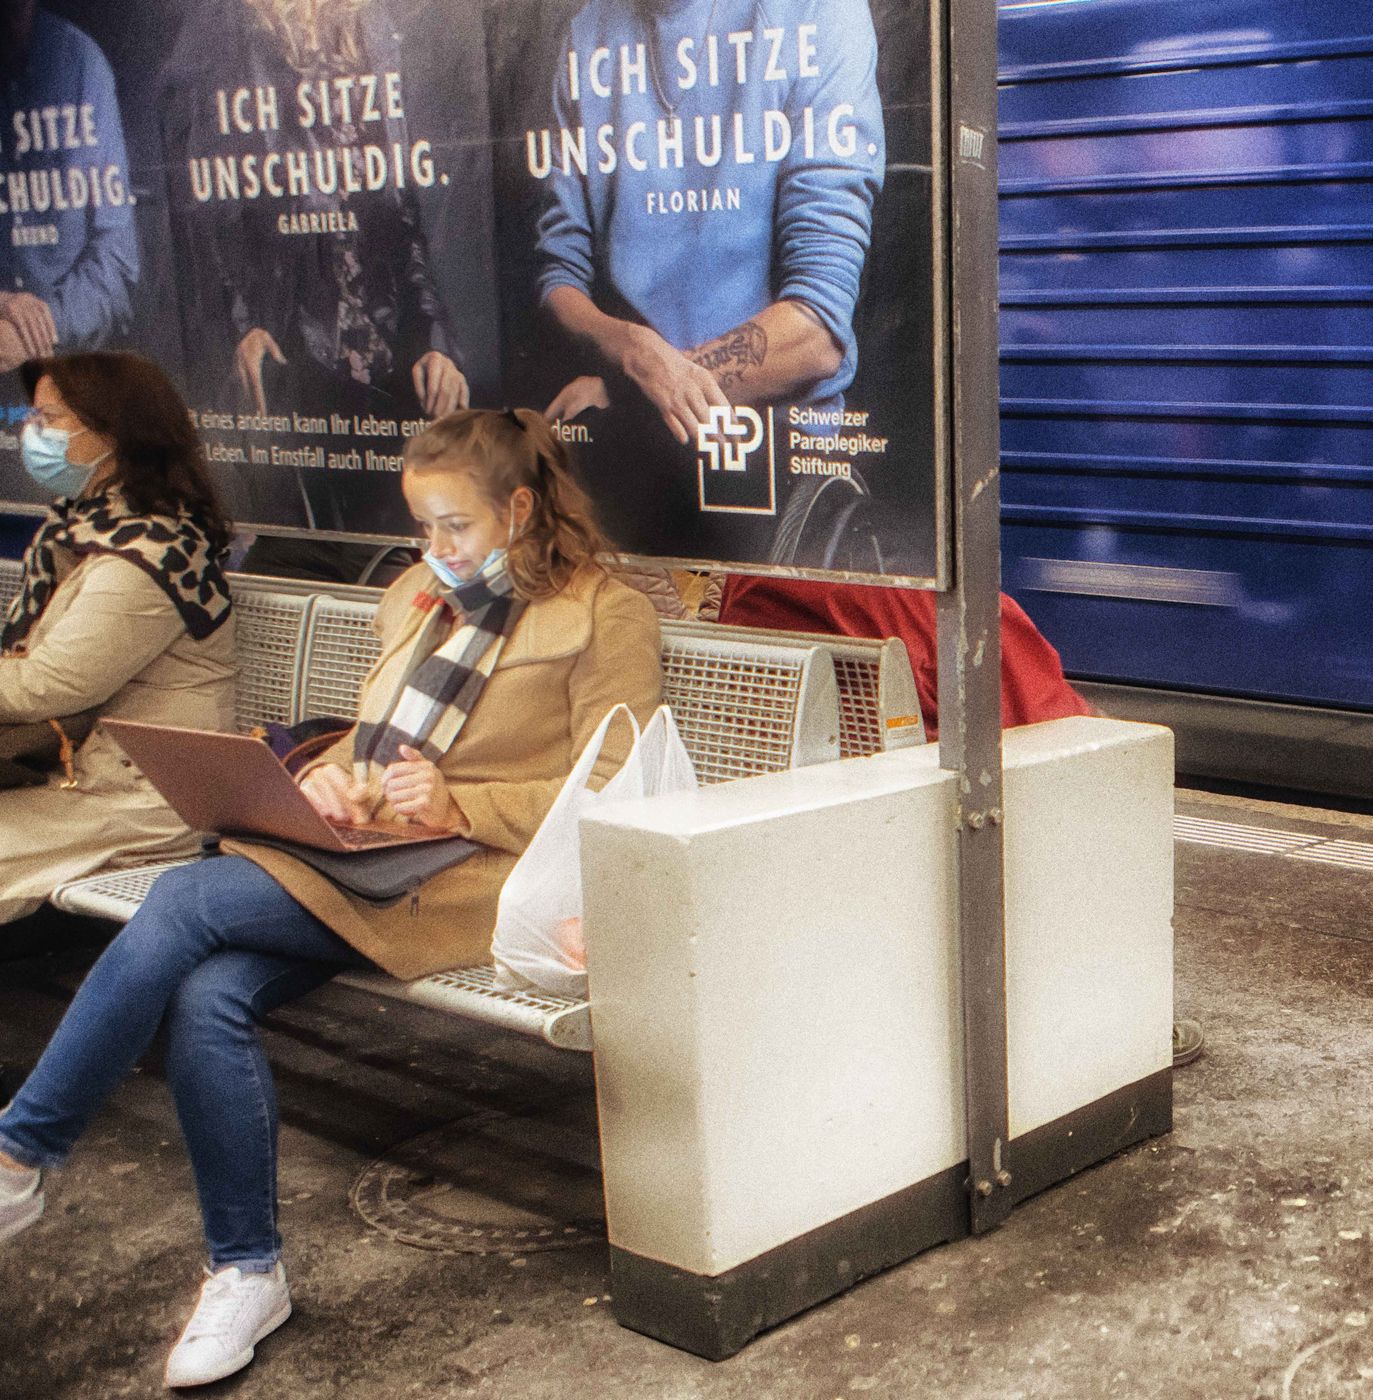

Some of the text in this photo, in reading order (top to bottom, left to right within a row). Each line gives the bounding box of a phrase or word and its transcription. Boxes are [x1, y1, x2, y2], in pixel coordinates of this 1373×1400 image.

[568, 24, 821, 101] ICH SITZE
[216, 72, 405, 135] ICH SITZE
[13, 102, 98, 153] SITZE
[526, 104, 878, 181] UNSCHULDIG.
[189, 140, 451, 203] UNSCHULDIG.
[646, 187, 741, 215] FLORIAN
[277, 211, 359, 235] GABRIELA
[237, 411, 291, 433] anderen
[292, 411, 329, 434] kann
[330, 412, 350, 435] Ihr
[353, 413, 399, 437] Leben
[788, 406, 870, 427] Schweizer
[788, 432, 889, 454] Paraplegiker
[250, 444, 269, 465] Im
[270, 444, 326, 468] Ernstfall
[327, 448, 363, 471] auch
[789, 457, 852, 478] Stiftung
